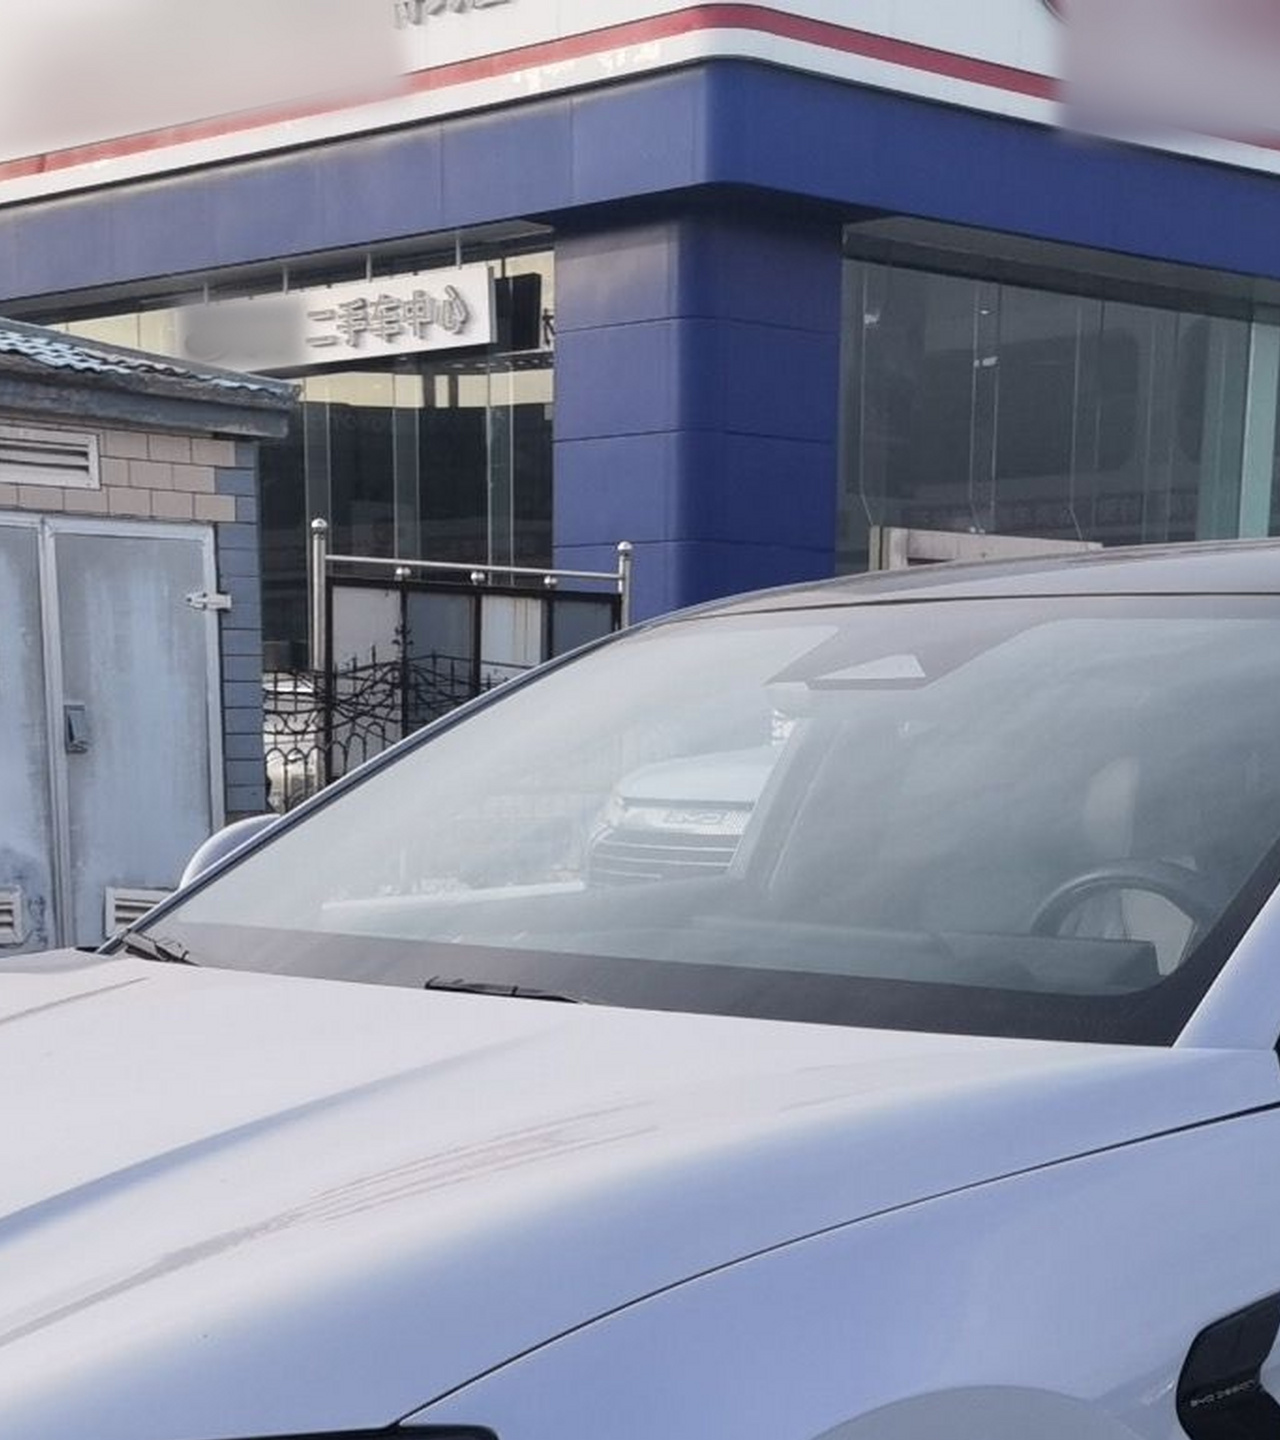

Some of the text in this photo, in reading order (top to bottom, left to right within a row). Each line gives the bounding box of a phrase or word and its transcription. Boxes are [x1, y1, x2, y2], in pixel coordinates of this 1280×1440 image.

[306, 285, 474, 347] 二手车中心
